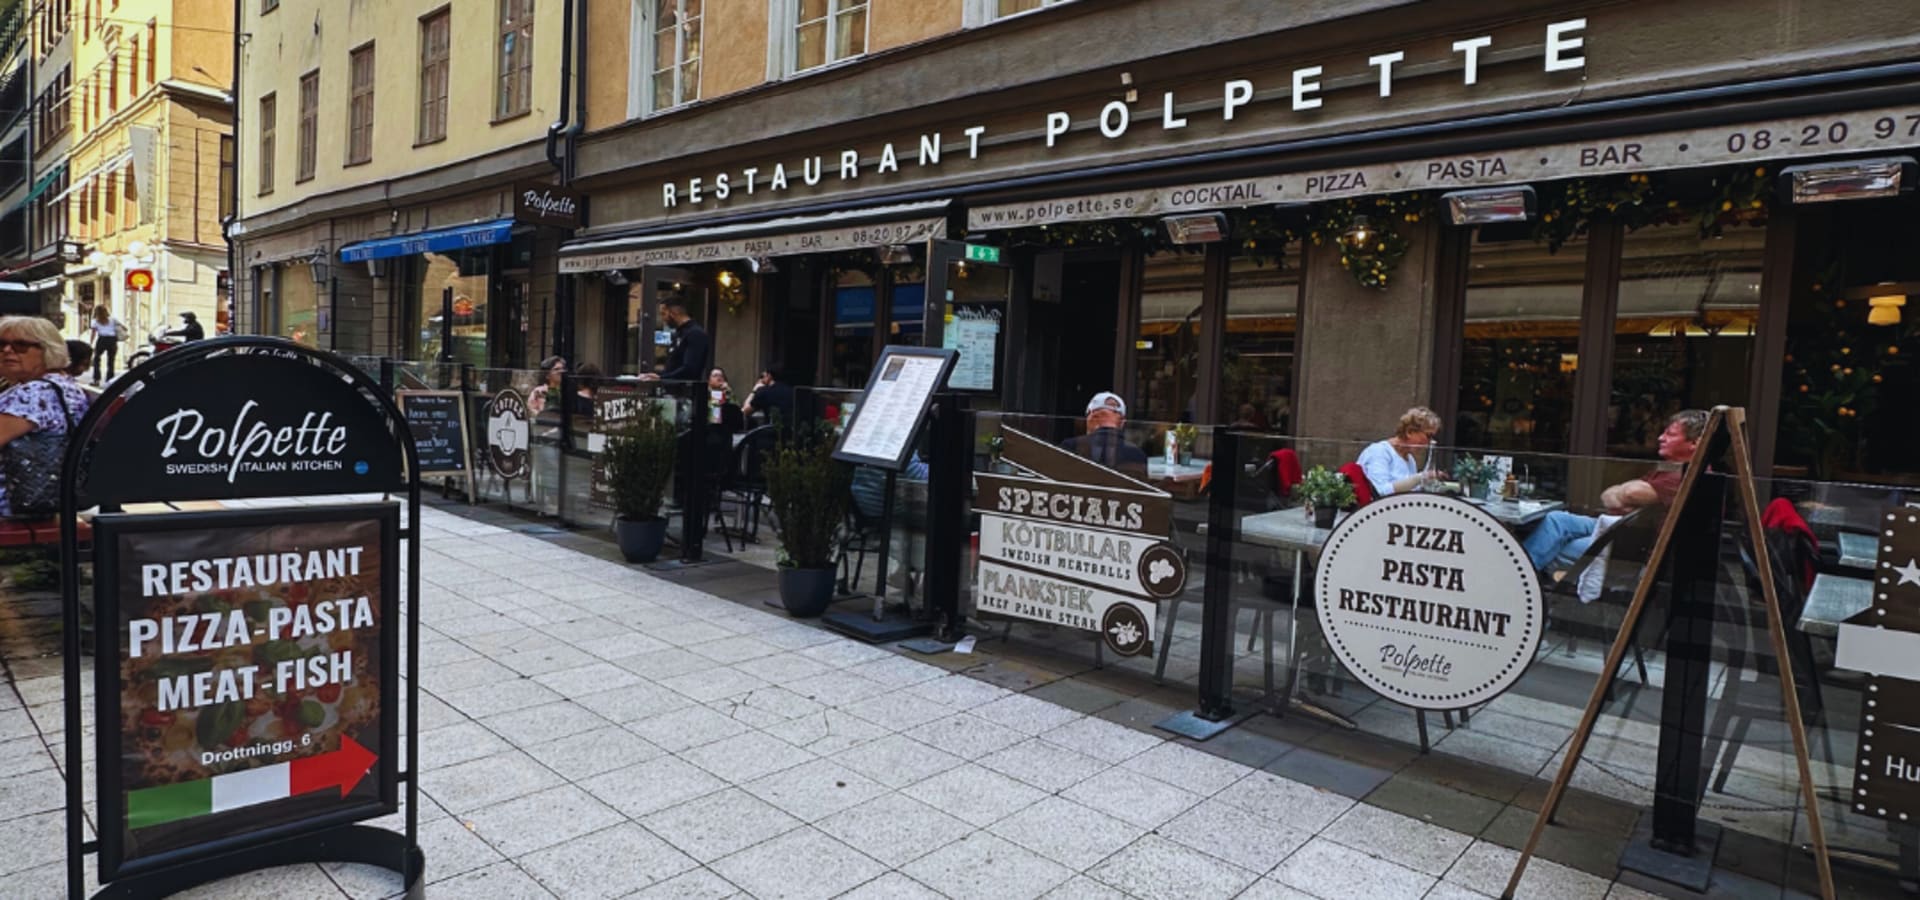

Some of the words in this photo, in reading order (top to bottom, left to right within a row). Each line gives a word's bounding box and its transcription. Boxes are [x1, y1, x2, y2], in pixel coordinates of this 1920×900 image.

[663, 125, 985, 208] RESTAURANT
[1047, 18, 1587, 147] POLPETTE
[980, 195, 1135, 223] www.polpette.se
[1171, 182, 1262, 206] COCKTAIL
[1305, 171, 1367, 194] PIZZA
[1427, 157, 1508, 180] PASTA
[1579, 143, 1644, 168] BAR
[1727, 121, 1849, 154] 08-20
[1874, 114, 1920, 140] 97
[523, 189, 576, 217] Polpette
[644, 249, 679, 262] COCKTAIL
[698, 246, 720, 257] PIZZA
[744, 240, 773, 251] PASTA
[801, 235, 823, 248] BAR
[852, 227, 889, 243] 08-20
[895, 225, 912, 241] 97
[156, 400, 347, 483] Polpette
[166, 462, 228, 474] SWEDISH
[239, 461, 287, 473] ITALIAN
[291, 460, 342, 471] KITCHEN
[997, 486, 1143, 529] SPECIALS
[1387, 522, 1466, 554] PIZZA
[141, 546, 364, 597] RESTAURANT
[1001, 547, 1050, 566] SWEDISH
[1058, 558, 1131, 581] MEATBALLS
[1381, 558, 1465, 592] PASTA
[983, 568, 1094, 614] PLANKSTEK
[128, 596, 374, 658] PIZZA-PASTA
[983, 595, 1010, 610] BEEF
[1015, 602, 1052, 620] PLANK
[1058, 611, 1097, 631] STEAK
[1338, 587, 1511, 637] RESTAURANT
[1379, 644, 1452, 678] Polpette
[157, 650, 352, 712] MEAT-FISH
[201, 738, 298, 766] Drottningg.
[301, 733, 312, 747] 6
[1885, 754, 1920, 783] Hu
